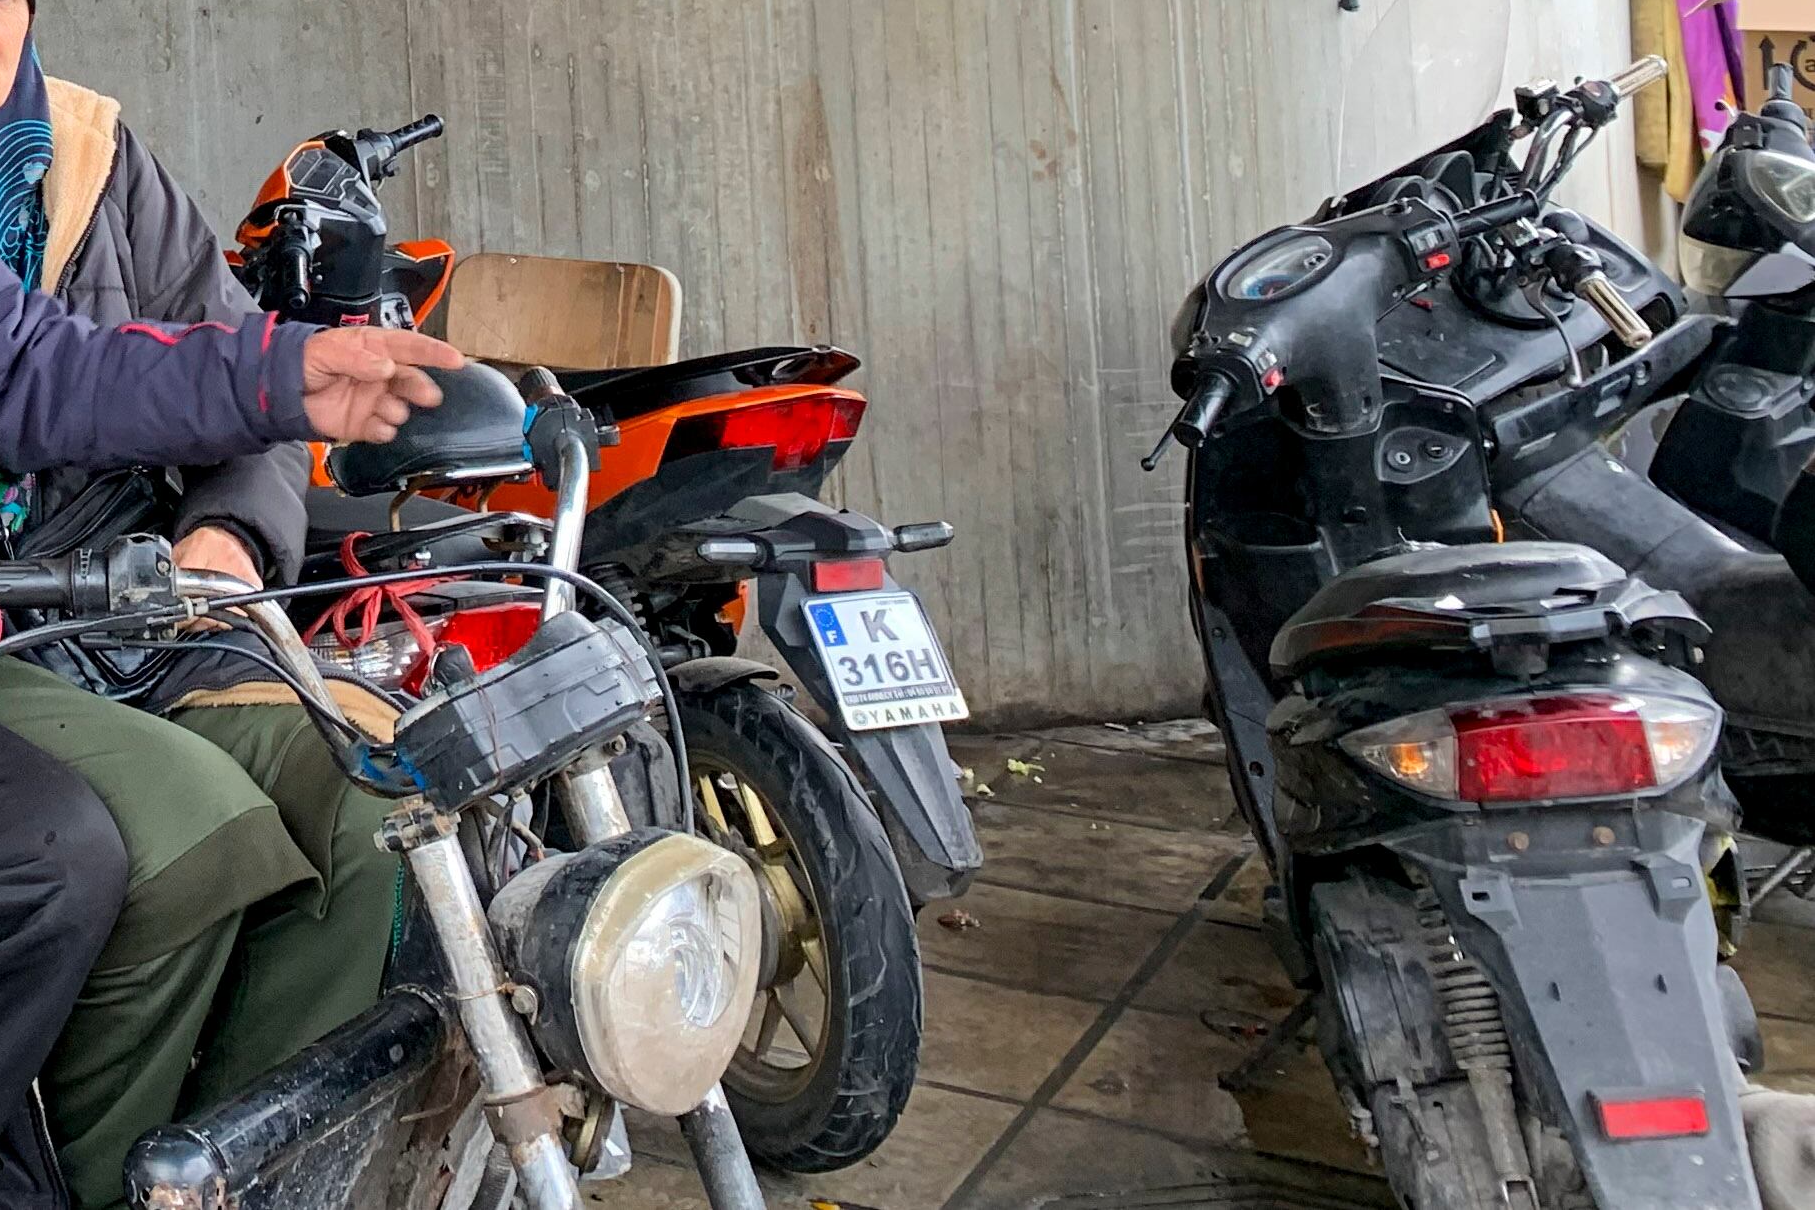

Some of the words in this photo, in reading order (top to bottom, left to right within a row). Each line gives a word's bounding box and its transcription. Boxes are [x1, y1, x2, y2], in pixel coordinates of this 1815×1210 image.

[826, 630, 838, 644] F
[860, 608, 900, 643] K
[838, 648, 940, 687] 316H
[868, 701, 961, 723] YAMAHA
